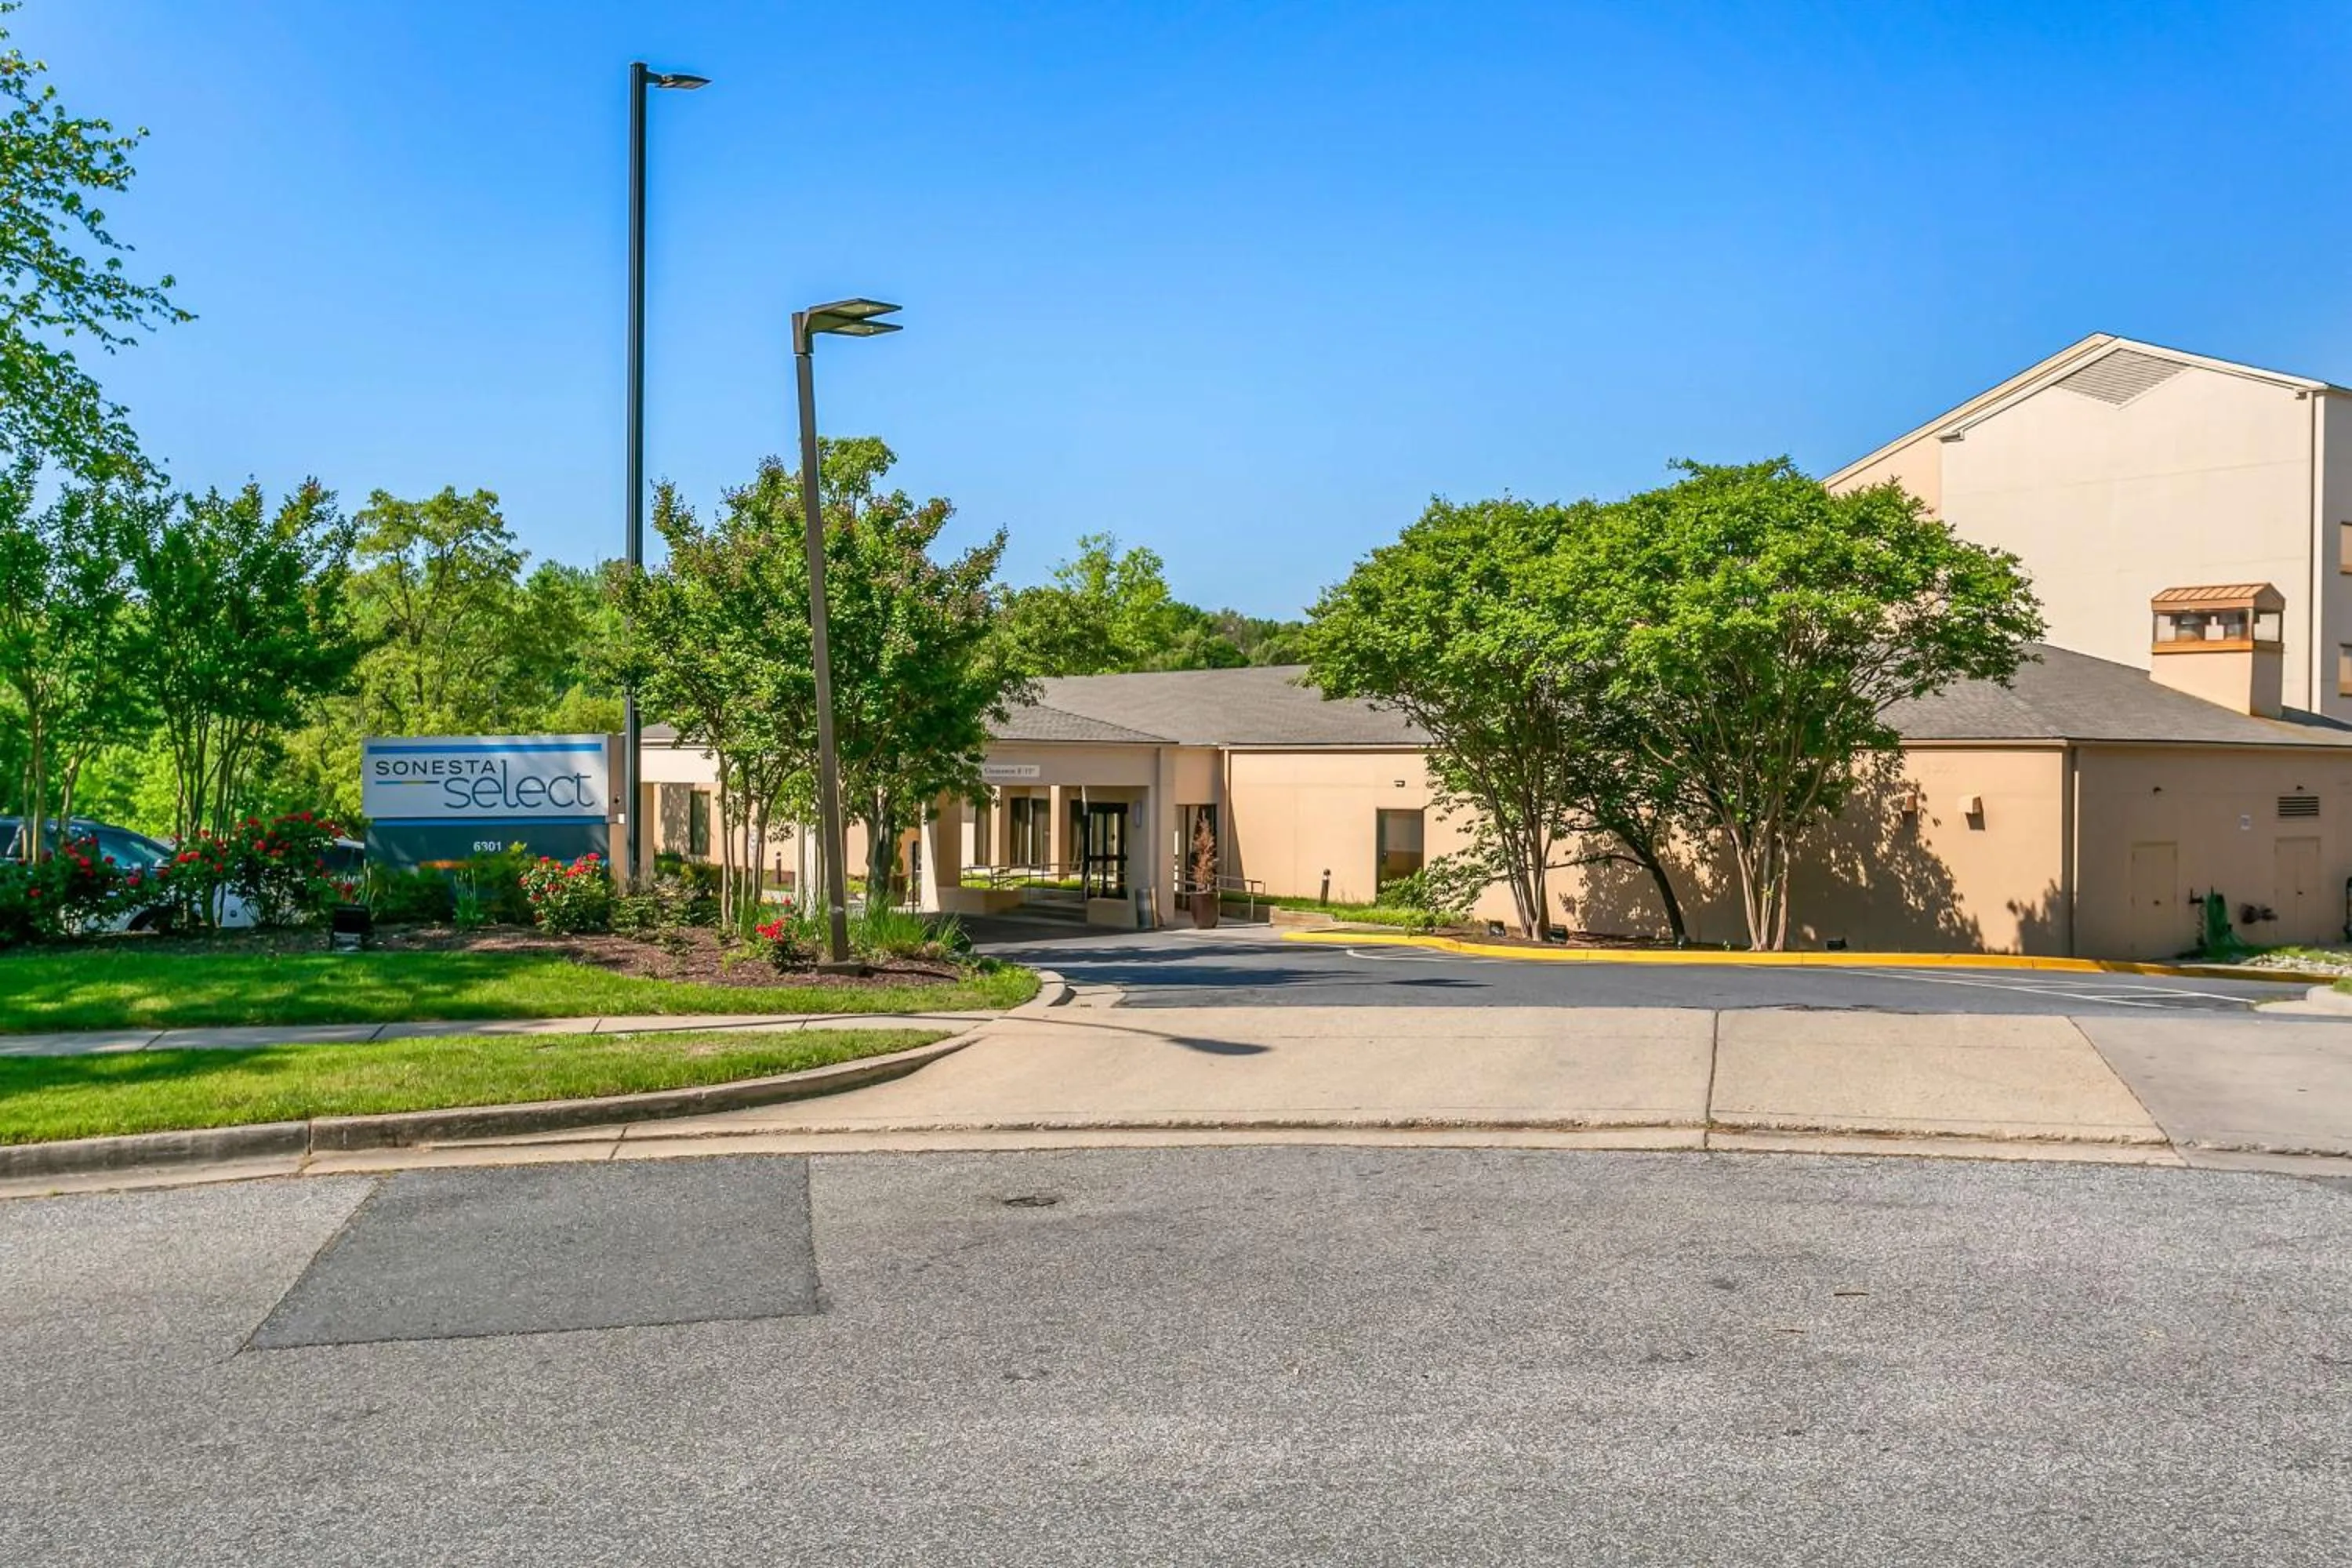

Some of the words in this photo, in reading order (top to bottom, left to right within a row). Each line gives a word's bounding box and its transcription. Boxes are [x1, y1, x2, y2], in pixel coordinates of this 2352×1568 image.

[375, 760, 497, 775] SONESTA
[444, 759, 595, 809] select
[473, 840, 502, 853] 6301
